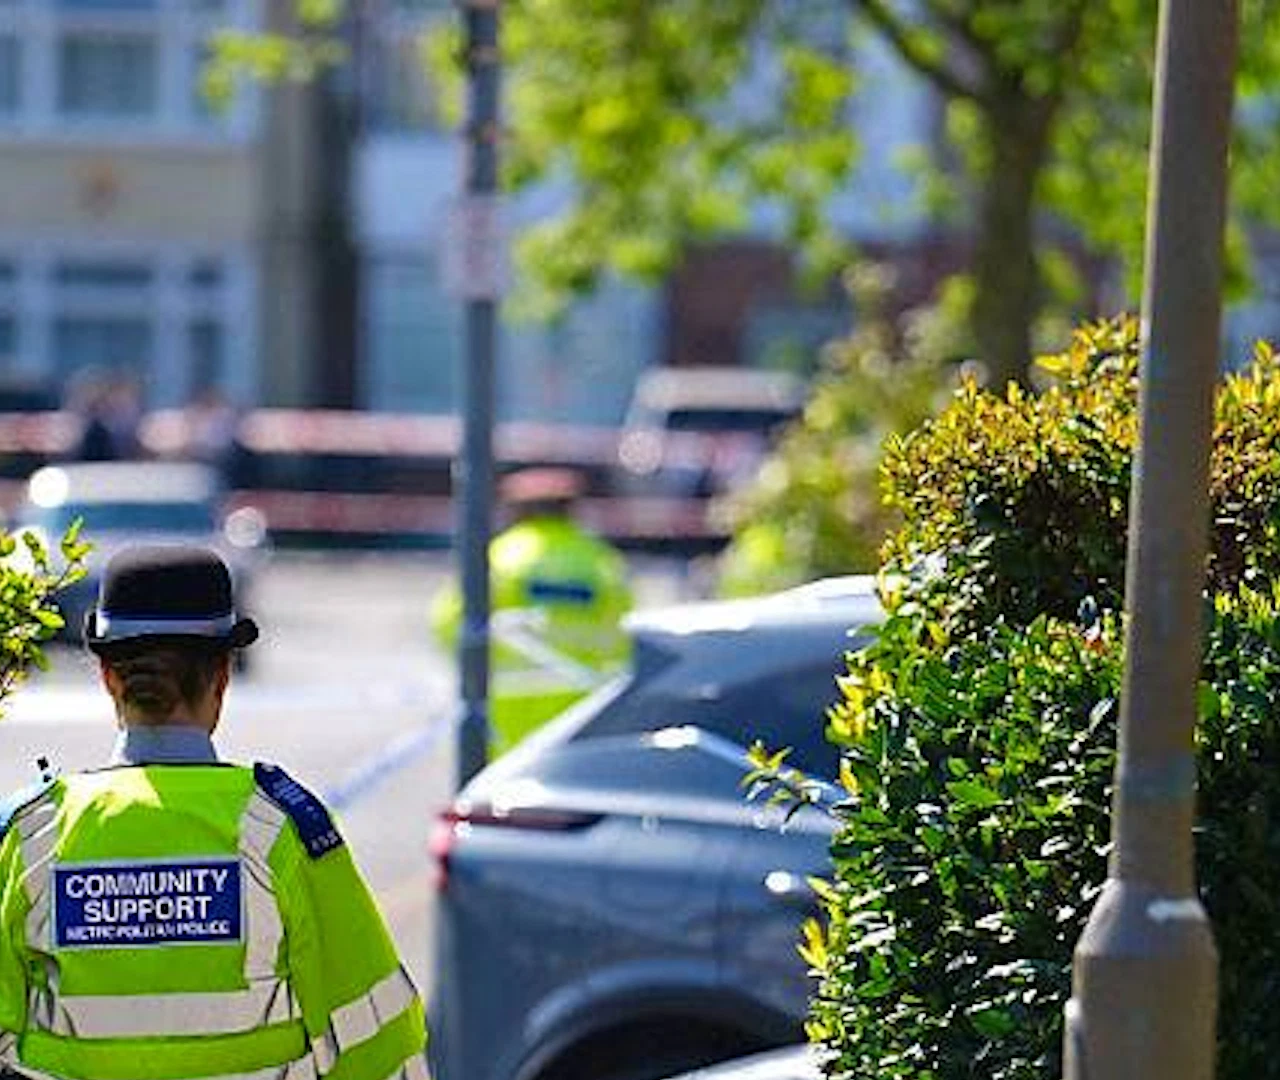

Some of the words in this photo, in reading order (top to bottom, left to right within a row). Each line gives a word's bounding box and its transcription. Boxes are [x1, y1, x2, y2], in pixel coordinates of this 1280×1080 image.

[65, 869, 228, 898] COMMUNITY
[83, 896, 212, 923] SUPPORT
[177, 919, 231, 935] POLICE
